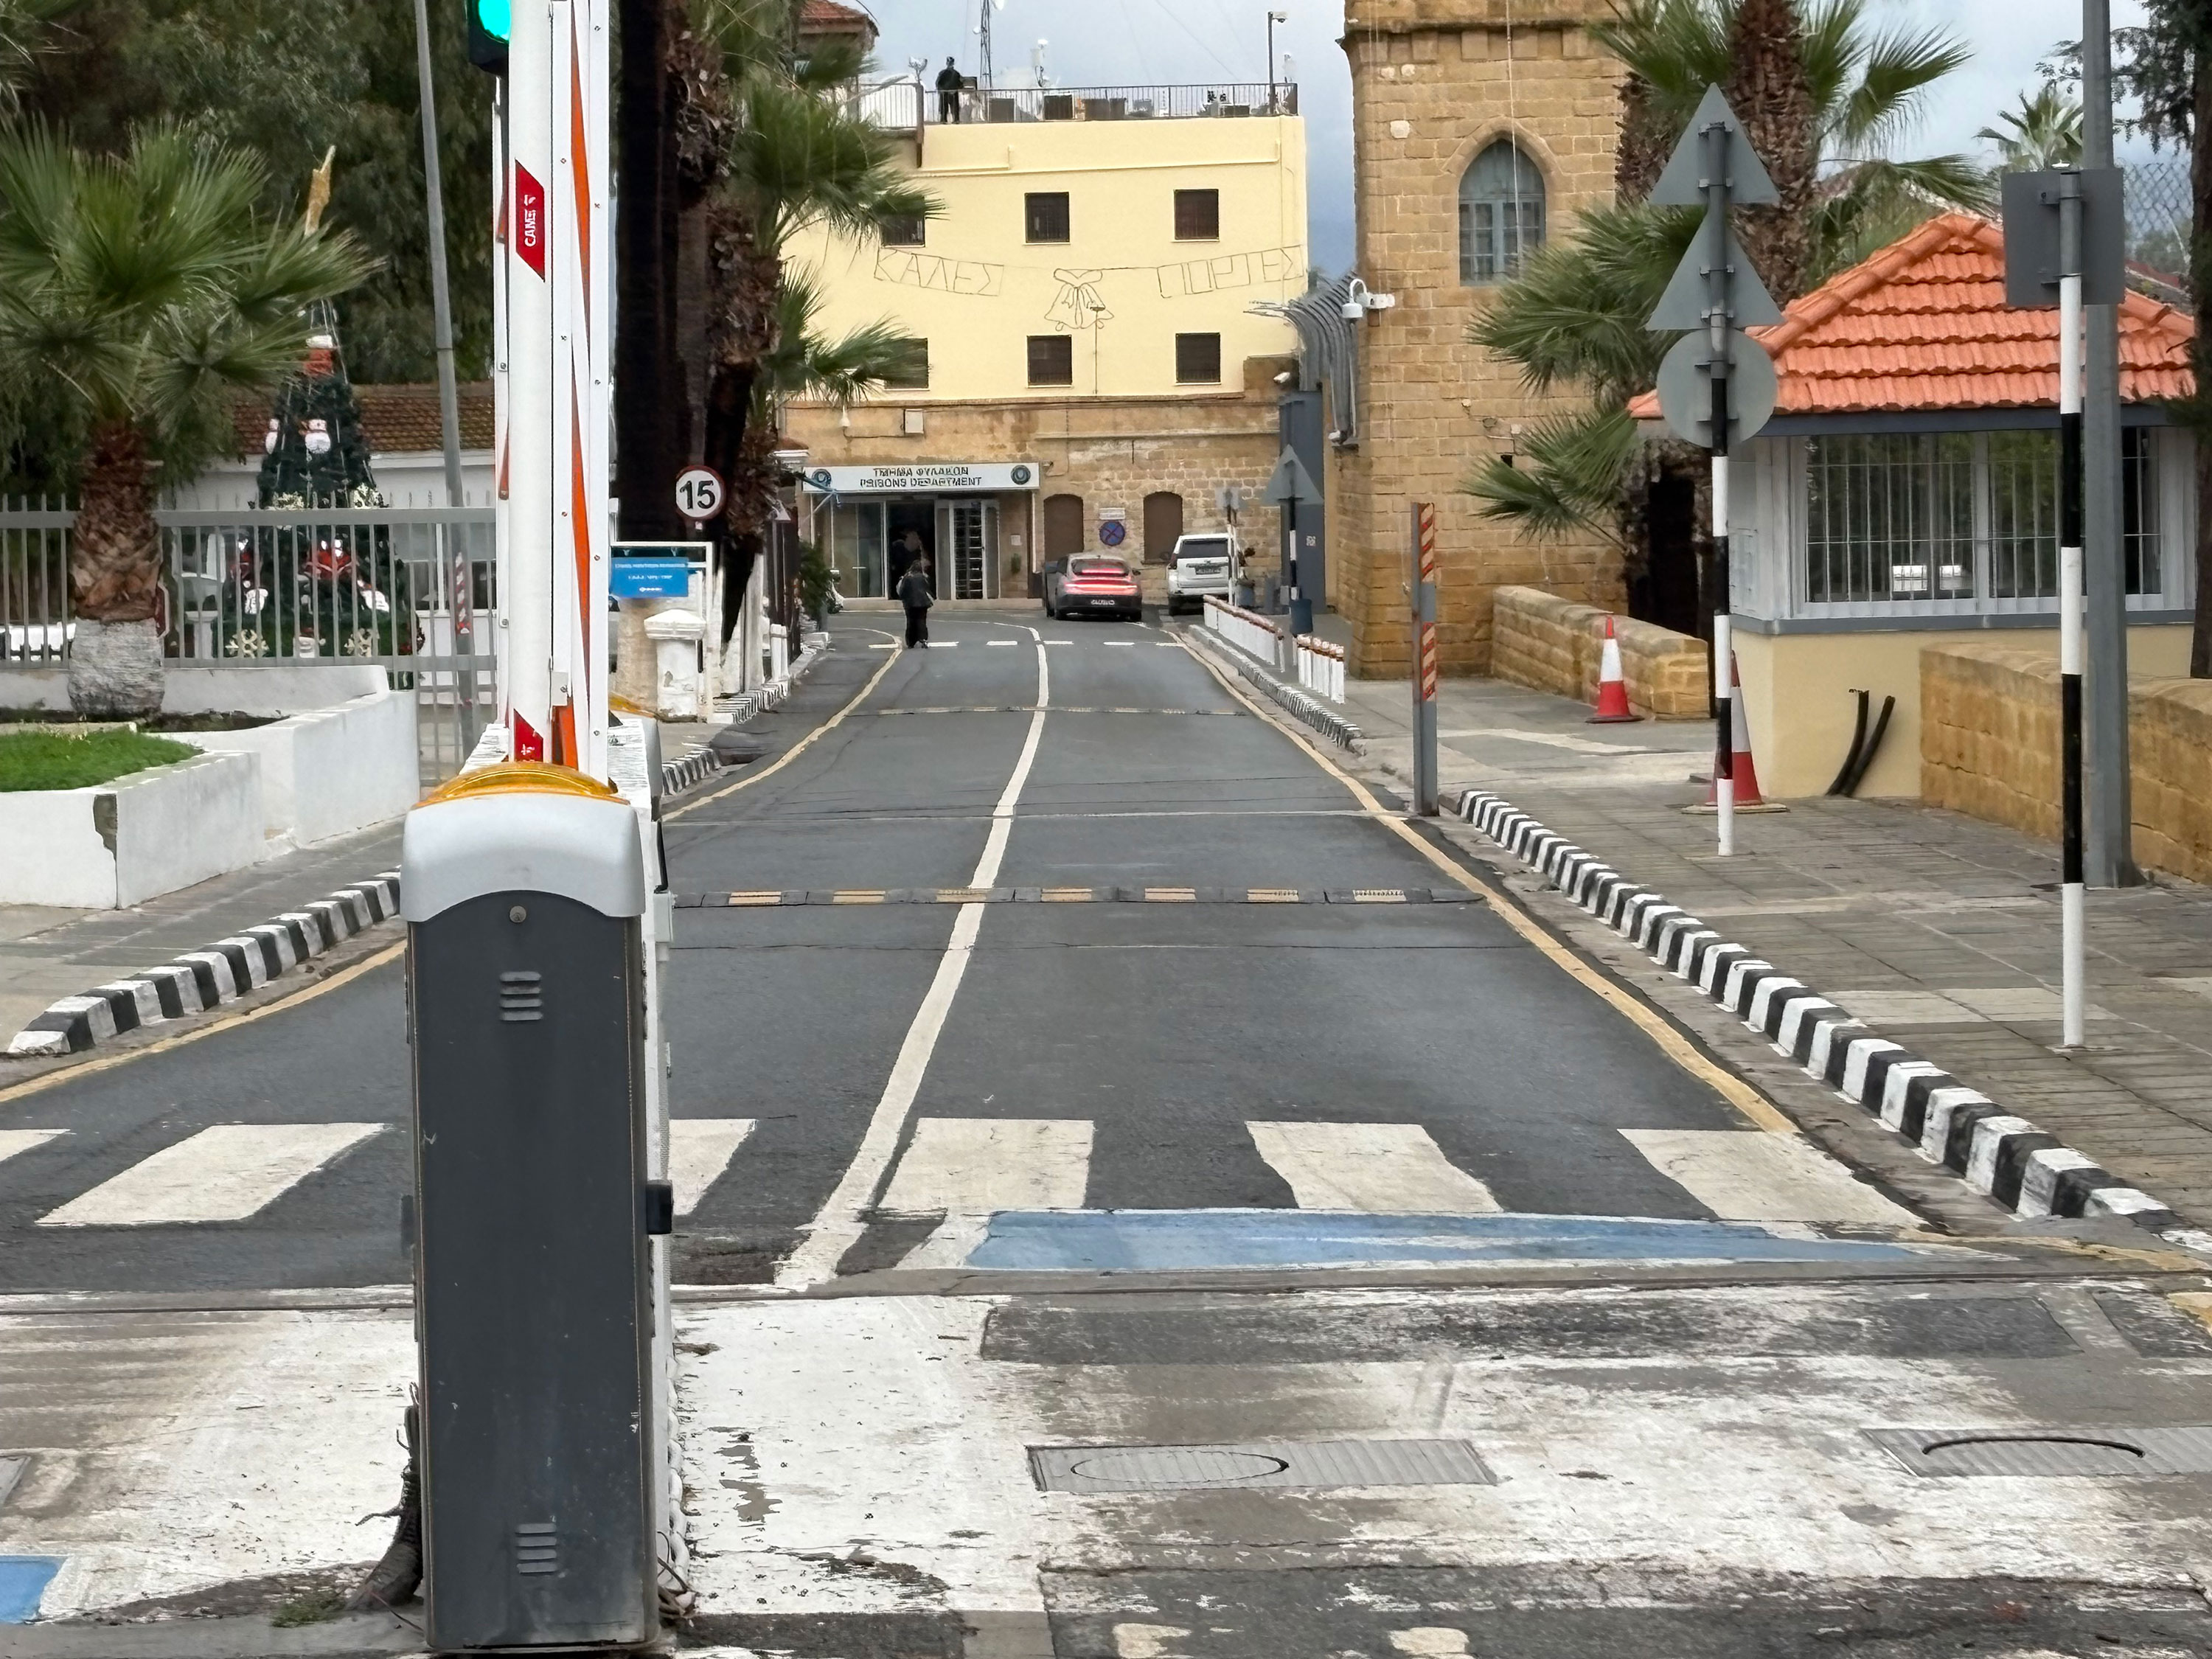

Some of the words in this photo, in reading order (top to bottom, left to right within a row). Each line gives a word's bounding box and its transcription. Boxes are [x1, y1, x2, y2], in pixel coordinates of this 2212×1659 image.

[524, 209, 536, 247] CAME
[679, 480, 716, 509] 15
[910, 476, 983, 487] DEPARTMENT
